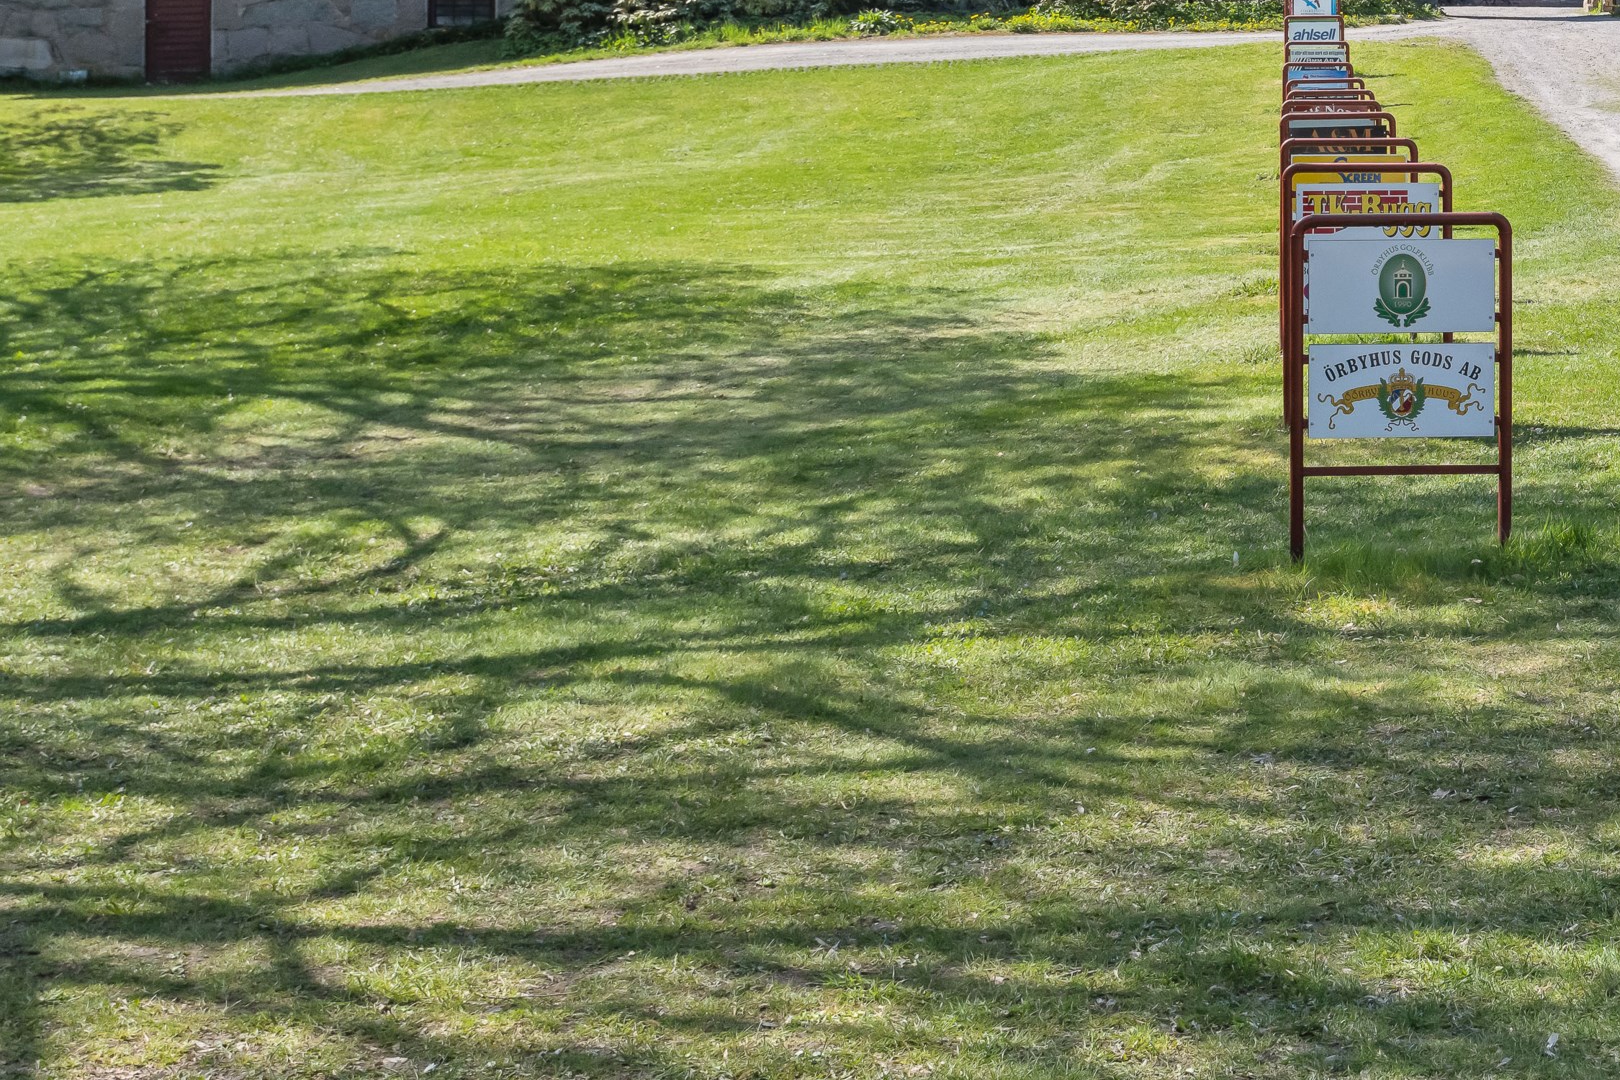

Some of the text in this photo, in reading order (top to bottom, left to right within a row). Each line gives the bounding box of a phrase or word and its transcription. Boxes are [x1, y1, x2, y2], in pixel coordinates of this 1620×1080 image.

[1293, 28, 1336, 41] ahlsell
[1334, 156, 1381, 184] SCREEN
[1370, 243, 1434, 276] ÖRBYHUS GOLFKLUBB
[1323, 350, 1482, 383] ÖRBYHUS GODS AB
